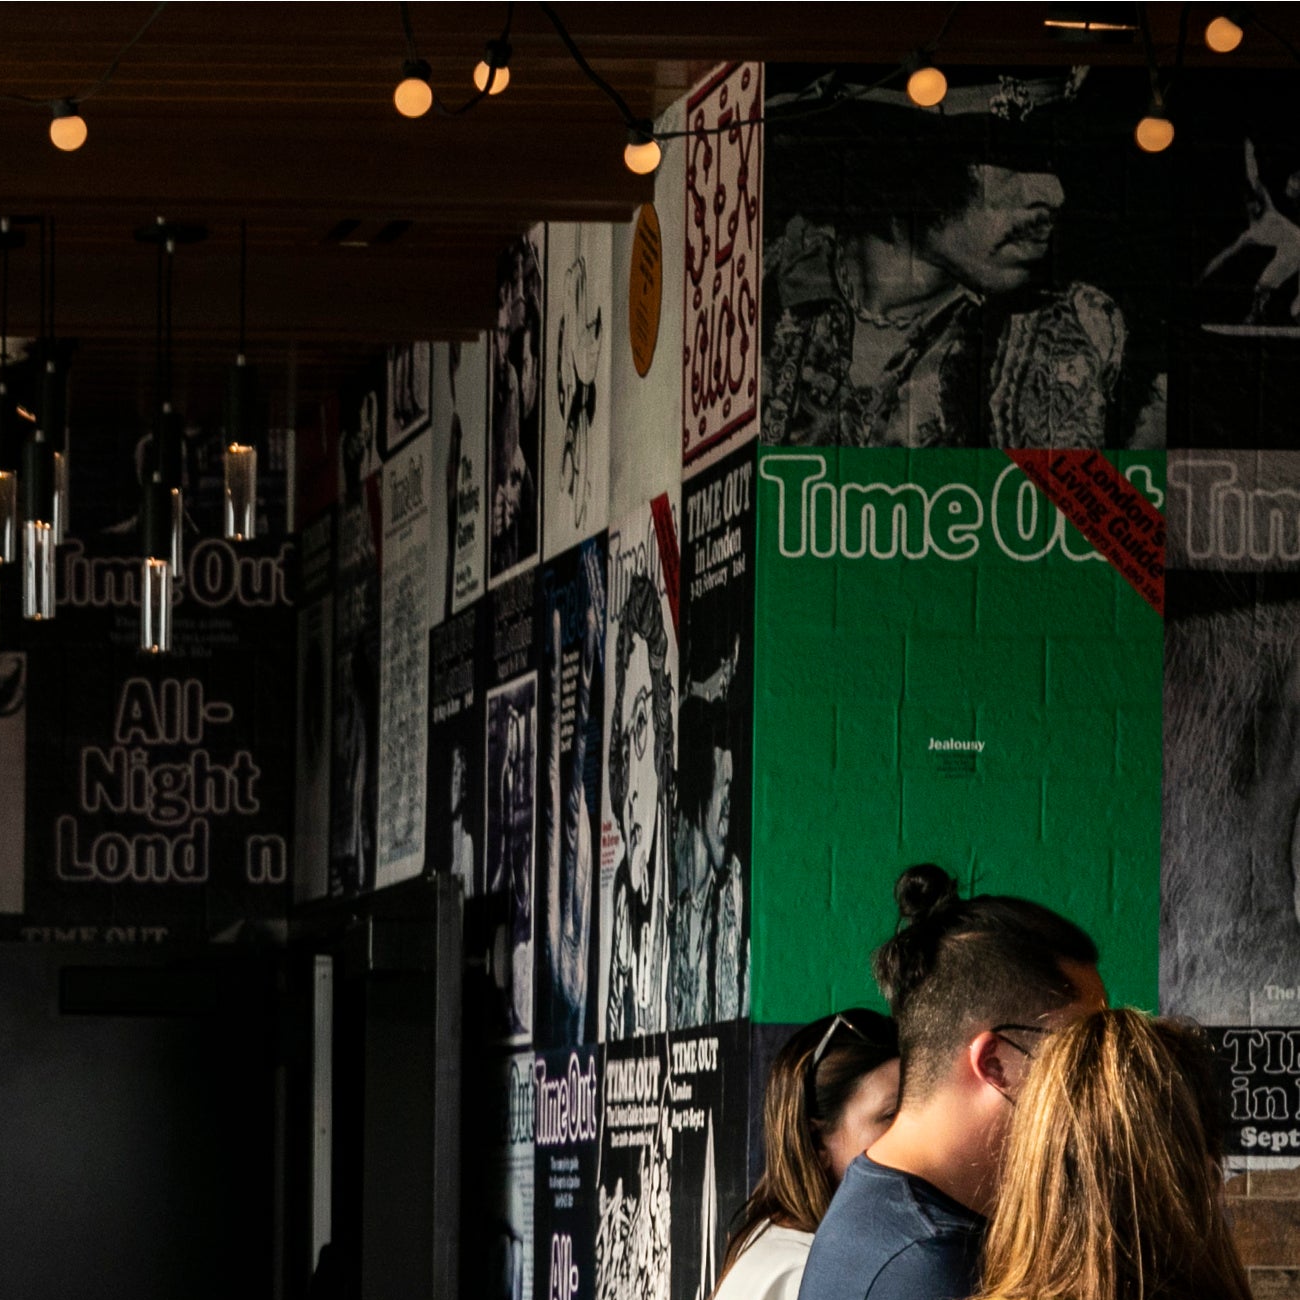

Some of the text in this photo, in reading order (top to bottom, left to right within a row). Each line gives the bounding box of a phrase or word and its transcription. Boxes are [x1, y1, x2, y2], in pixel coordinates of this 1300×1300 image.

[687, 461, 752, 543] TIME OUT
[760, 454, 984, 560] Time
[1050, 456, 1106, 524] Living
[1108, 517, 1165, 579] Guide
[1081, 454, 1165, 547] London's
[1167, 459, 1300, 562] Tim
[54, 538, 186, 607] Tim
[695, 525, 741, 575] in London
[114, 677, 234, 746] All-
[928, 737, 985, 752] Jealousy
[81, 746, 261, 826] Night
[607, 1056, 660, 1103] TIME OUT
[672, 1037, 719, 1075] TIME OUT
[1223, 1029, 1300, 1074] TI
[510, 1060, 535, 1145] Out
[536, 1052, 597, 1145] Time Out
[1231, 1077, 1289, 1120] in
